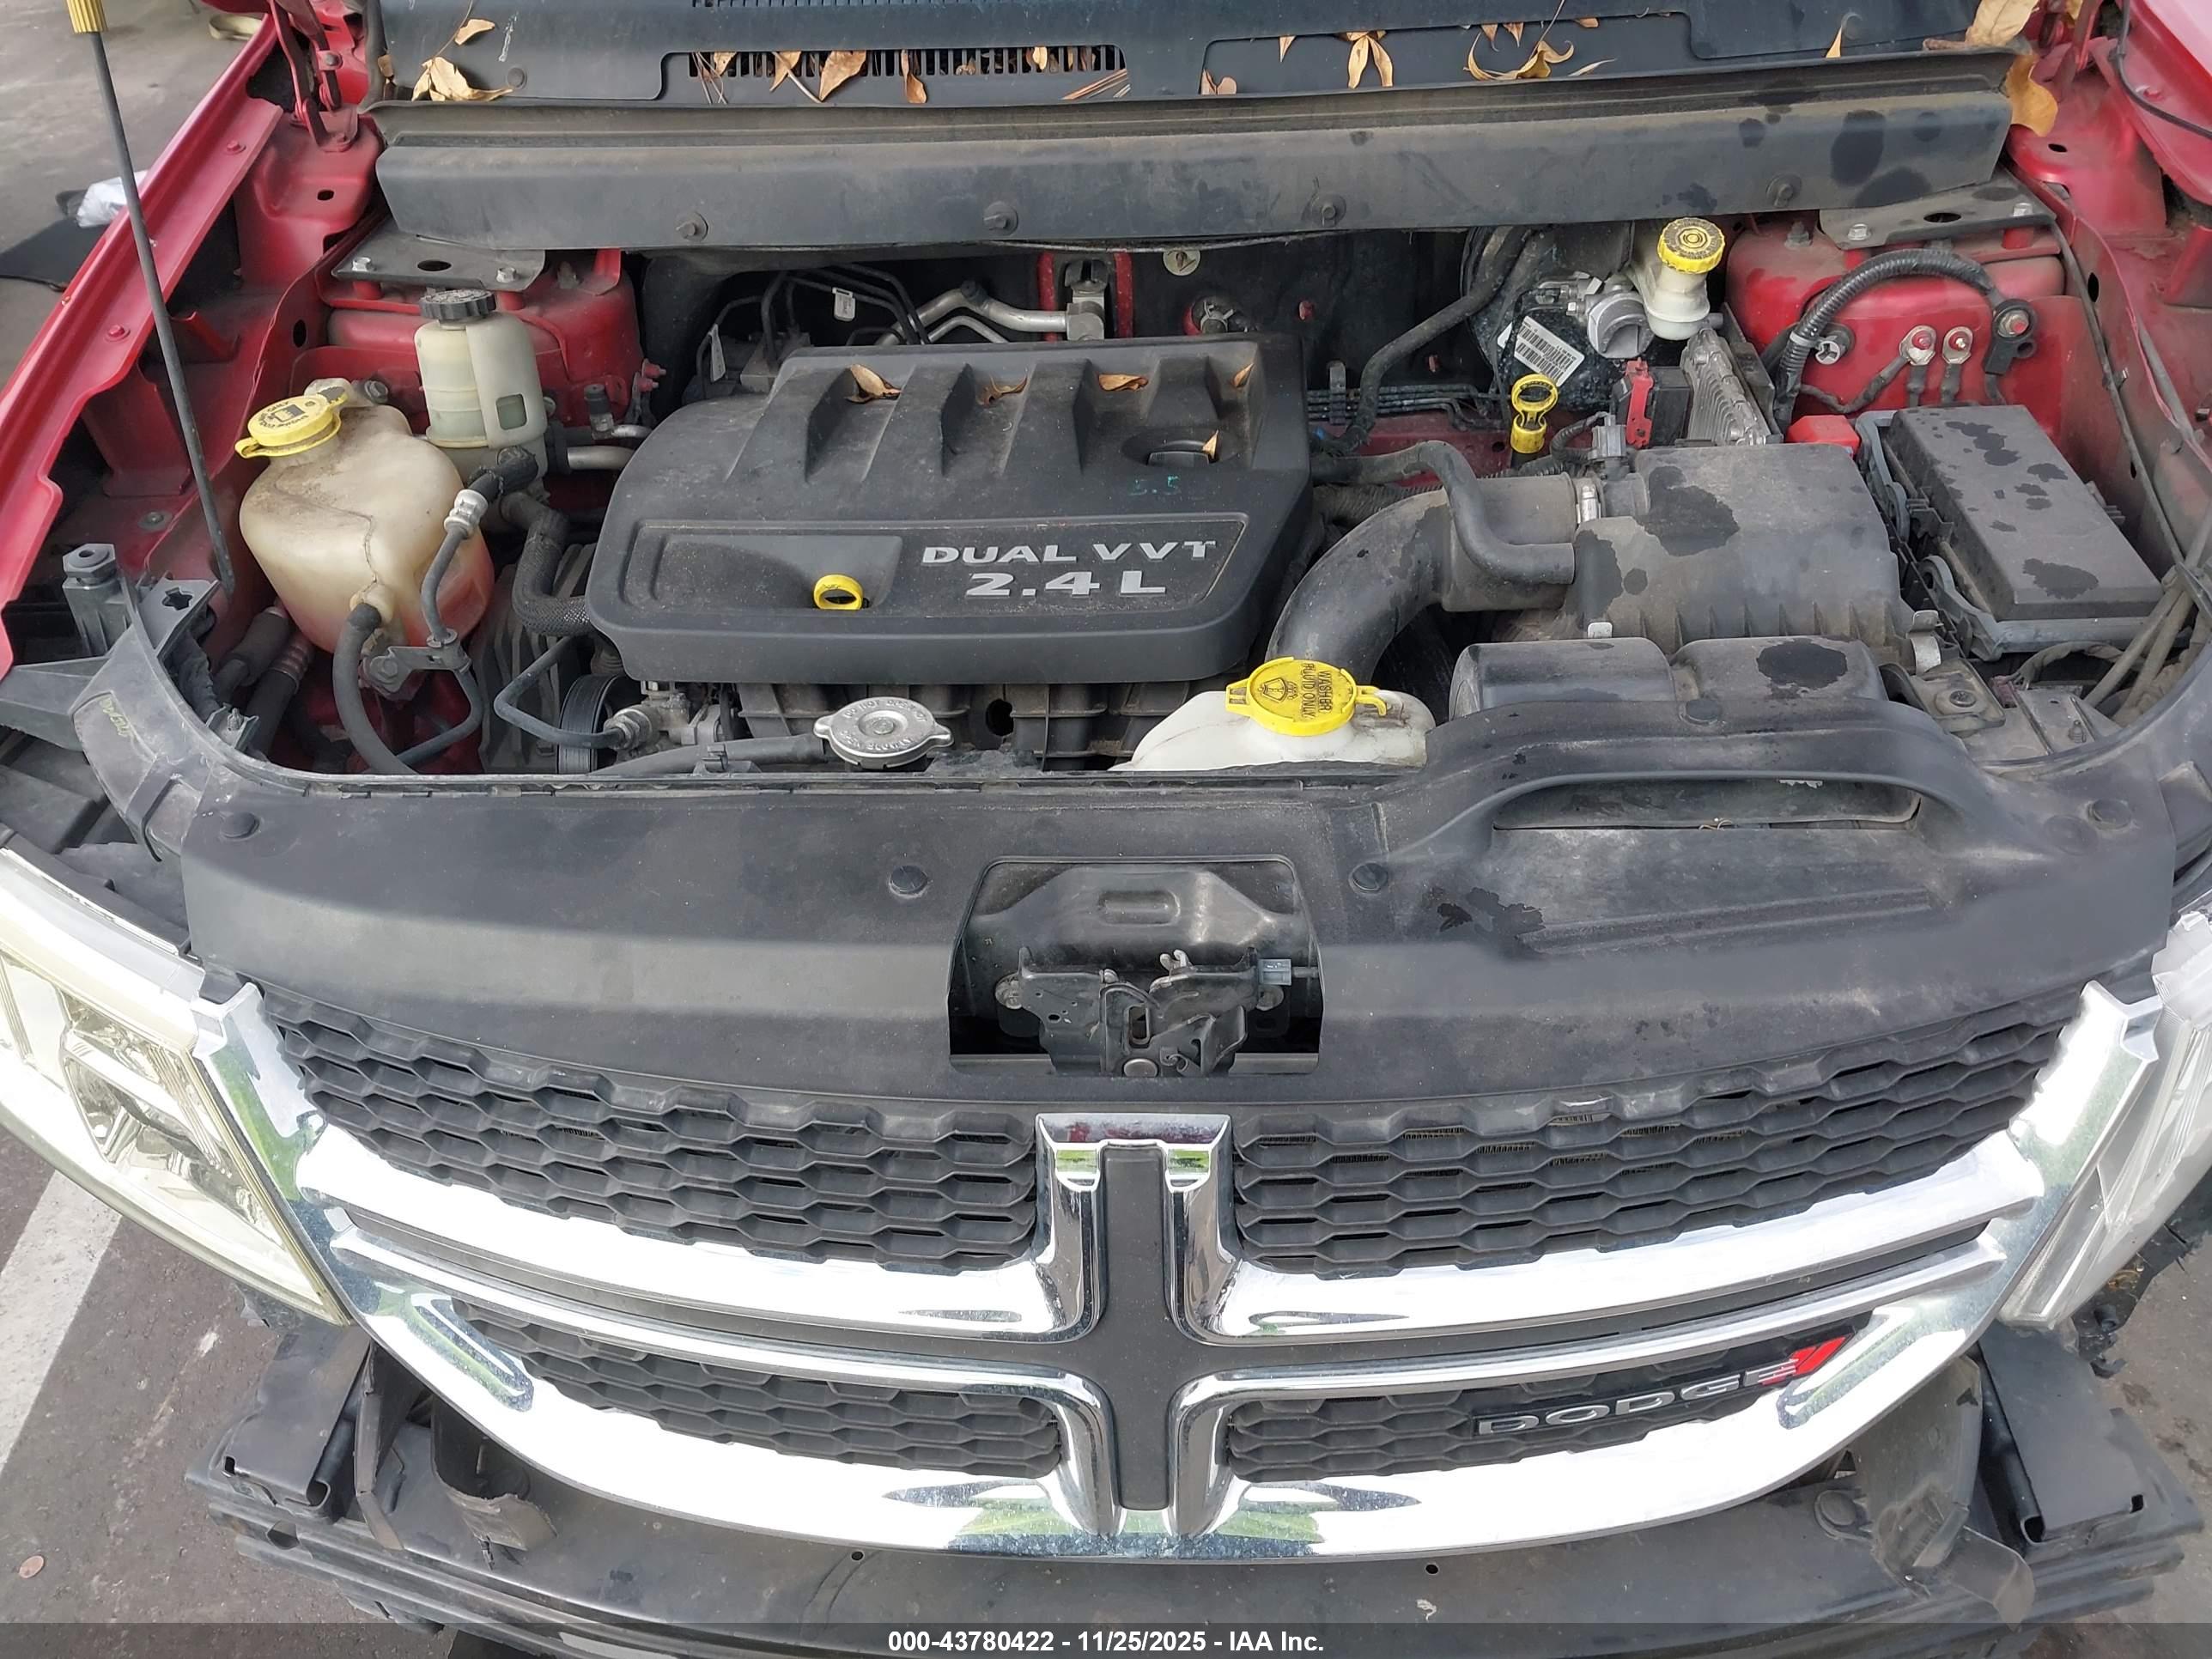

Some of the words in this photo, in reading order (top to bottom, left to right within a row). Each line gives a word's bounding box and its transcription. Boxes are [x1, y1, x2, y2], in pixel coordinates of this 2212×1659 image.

[921, 544, 1078, 565] DUAL
[1092, 540, 1217, 561] VVT
[965, 571, 1102, 598] 2.4
[1119, 570, 1167, 596] L
[1301, 663, 1316, 692] FLUID
[1317, 669, 1333, 714] WASHER
[1301, 693, 1316, 720] ONLY
[1478, 1358, 1801, 1436] DODGE
